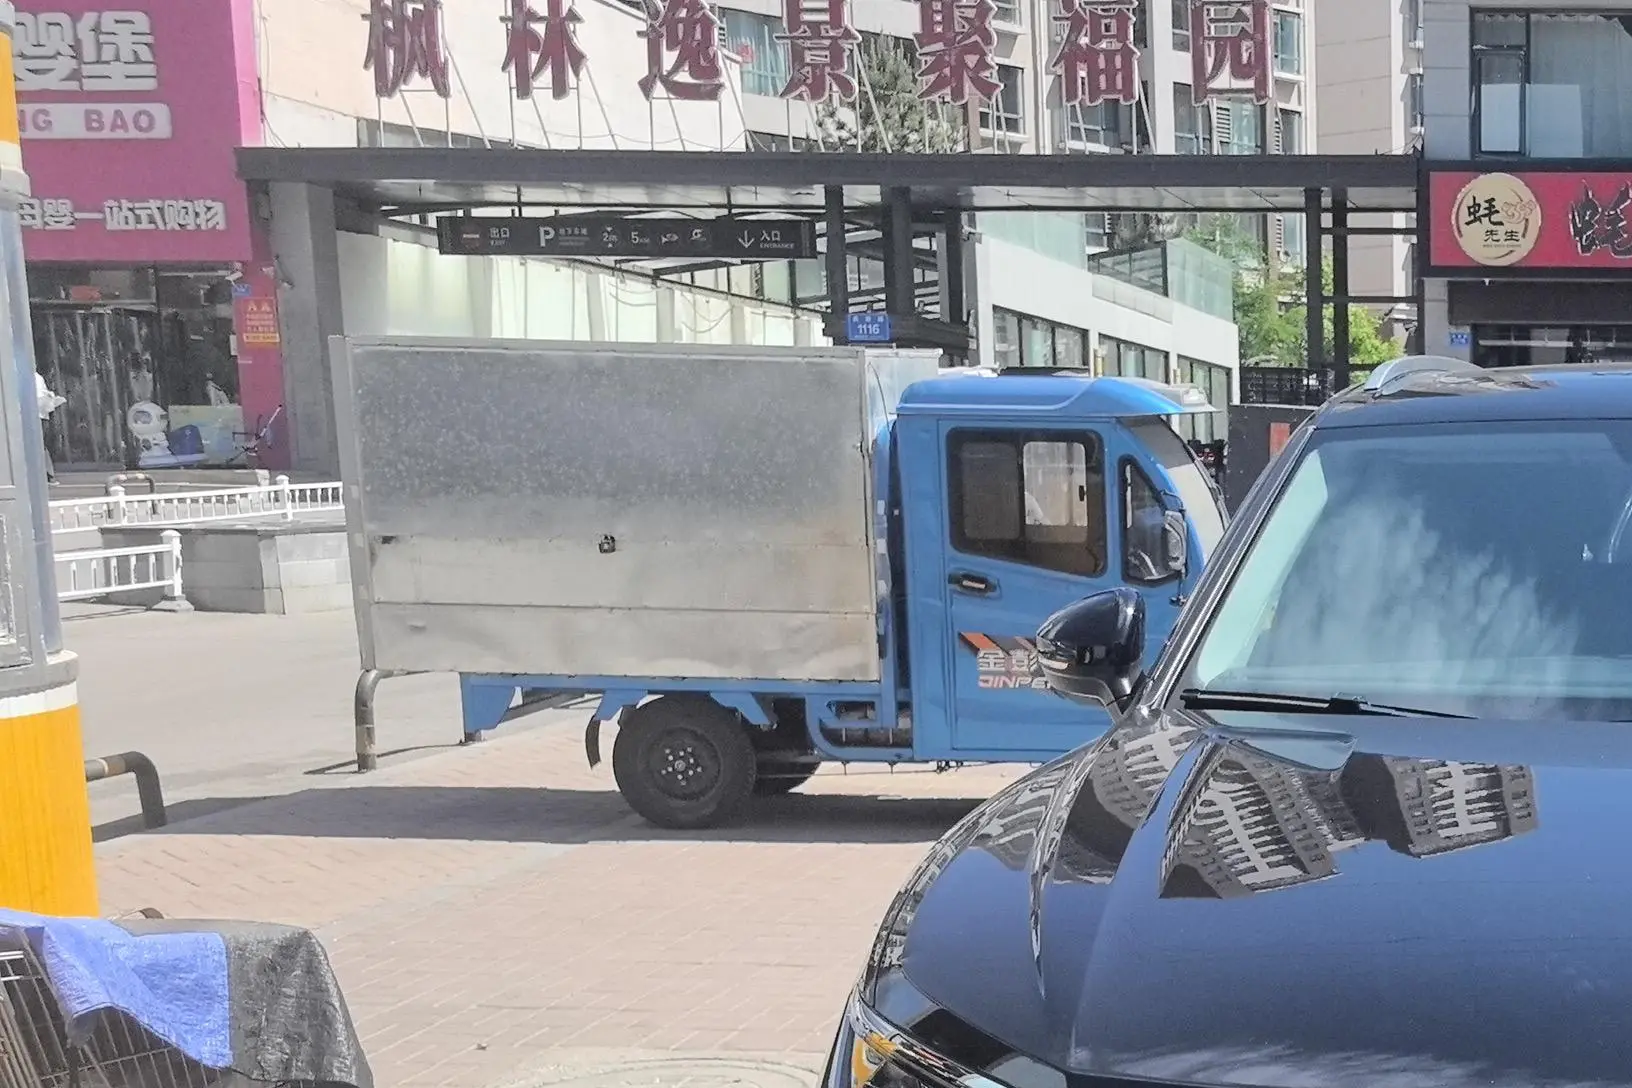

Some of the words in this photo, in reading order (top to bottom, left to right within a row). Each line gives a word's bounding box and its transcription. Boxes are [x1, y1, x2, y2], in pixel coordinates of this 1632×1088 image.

[361, 0, 1273, 105] 枫林逸景聚福园
[84, 109, 156, 133] BAO
[18, 198, 227, 231] 母婴一站式购物
[1464, 195, 1505, 226] 蚝
[489, 227, 510, 239] 出口
[539, 227, 555, 247] P
[760, 230, 781, 241] 入口
[1484, 229, 1521, 242] 先生
[857, 323, 880, 335] 1116
[978, 675, 1051, 689] JINPE
